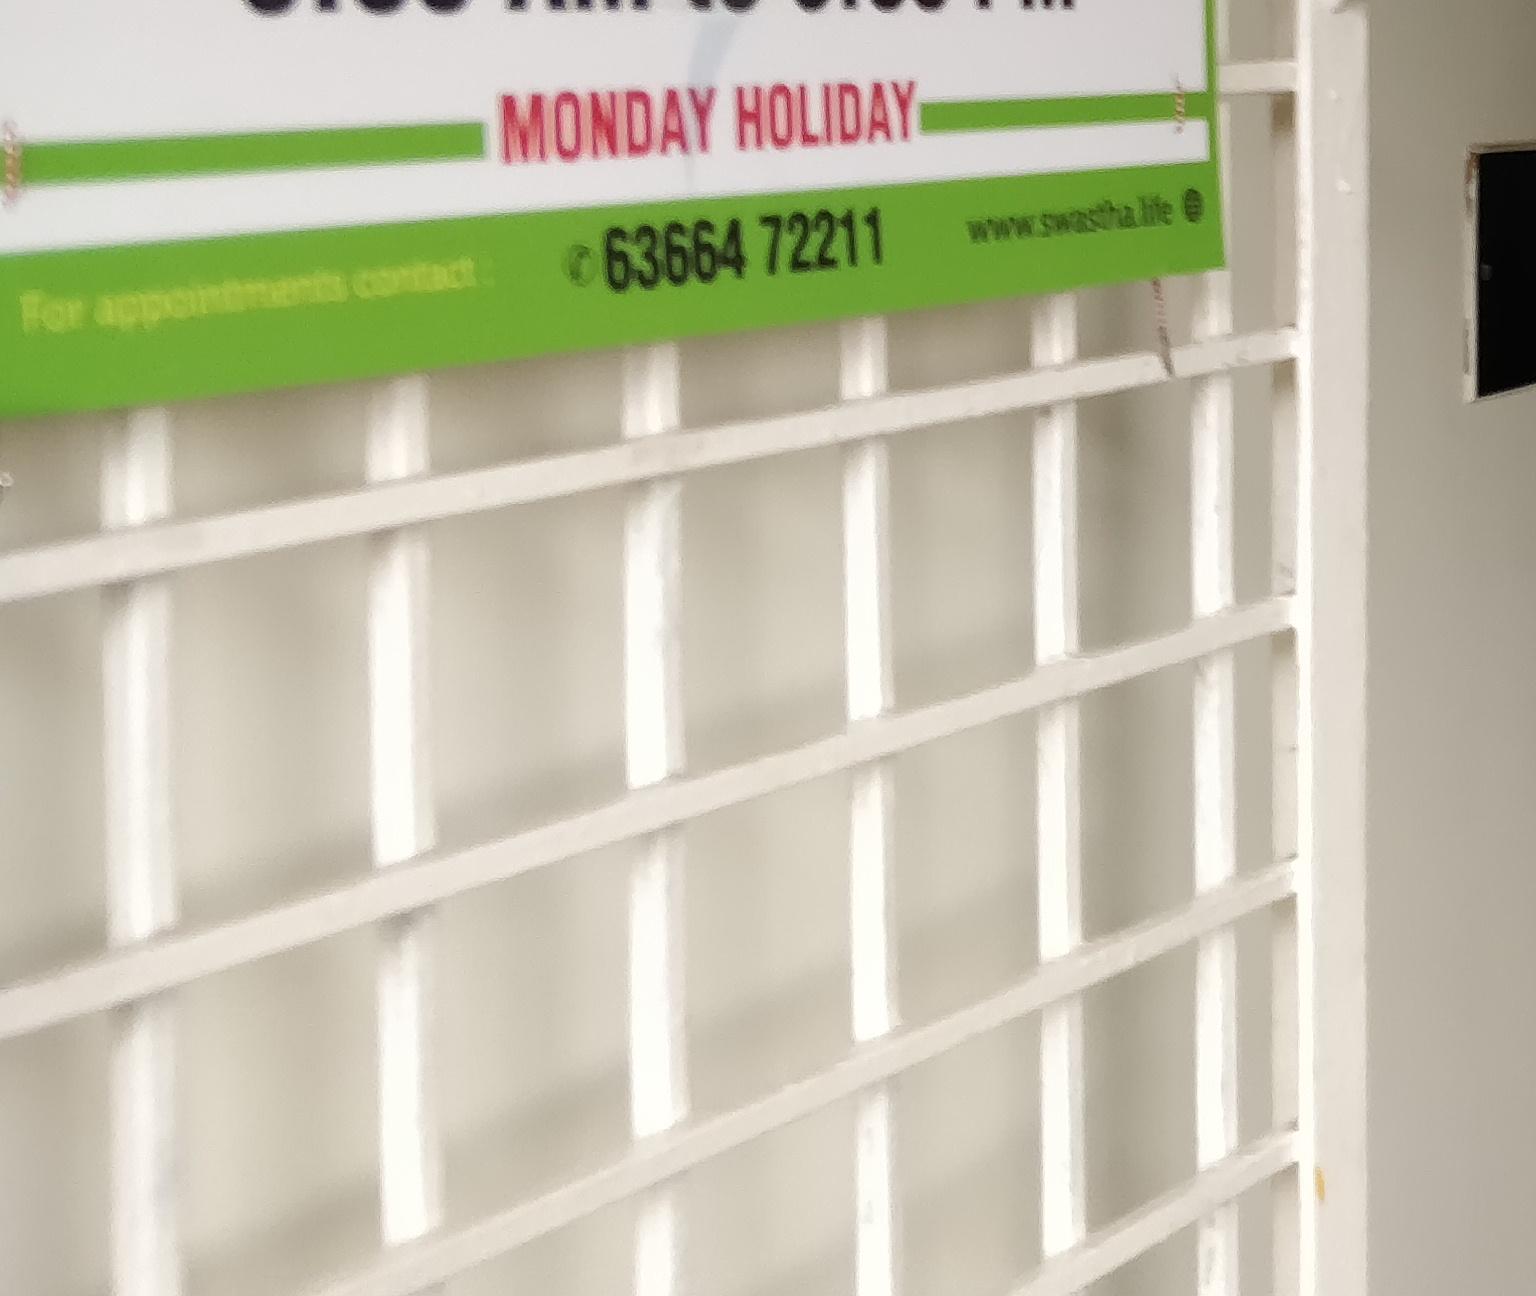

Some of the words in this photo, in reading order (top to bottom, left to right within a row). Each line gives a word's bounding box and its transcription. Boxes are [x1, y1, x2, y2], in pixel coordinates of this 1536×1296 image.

[499, 88, 716, 166] MONDAY
[736, 81, 917, 150] HOLIDAY
[604, 219, 747, 292] 63664
[759, 207, 883, 275] 72211
[968, 195, 1174, 243] www.swastha.life
[20, 290, 83, 333] For
[355, 256, 478, 299] contact
